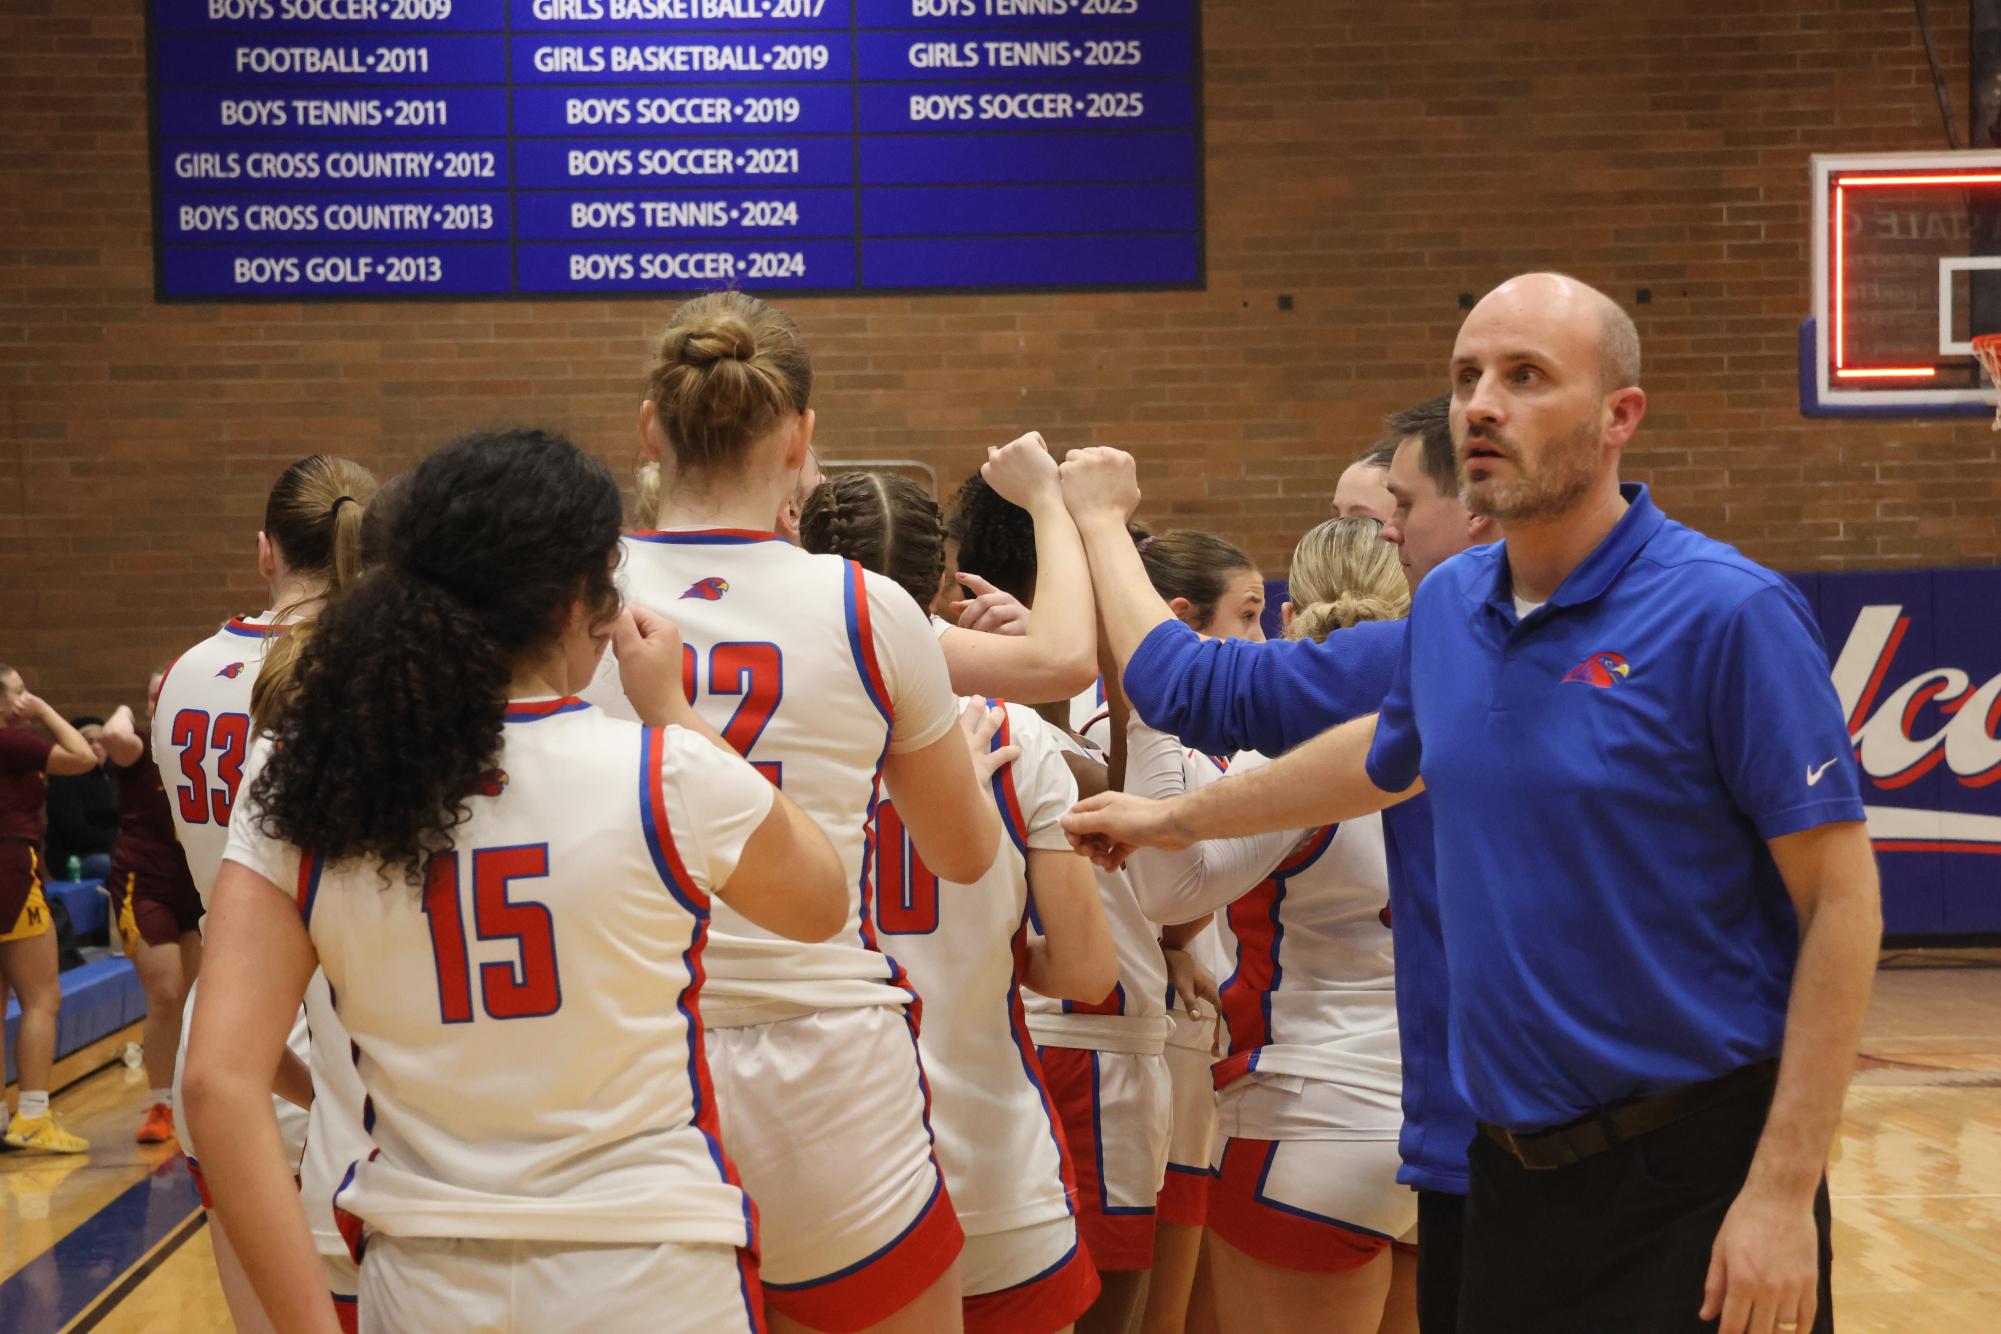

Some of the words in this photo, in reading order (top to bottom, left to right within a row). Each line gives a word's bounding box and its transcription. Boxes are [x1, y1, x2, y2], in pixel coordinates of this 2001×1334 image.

[208, 0, 275, 20] BOYS
[532, 0, 605, 21] GIRLS
[911, 0, 976, 18] BOYS
[533, 46, 606, 73] GIRLS
[908, 41, 980, 68] GIRLS
[221, 100, 287, 126] BOYS
[566, 98, 632, 125] BOYS
[909, 94, 974, 121] BOYS
[175, 153, 241, 178] GIRLS
[246, 152, 321, 179] CROSS
[568, 149, 634, 176] BOYS
[179, 205, 240, 231] BOYS
[244, 204, 319, 231] CROSS
[570, 201, 636, 229] BOYS
[234, 257, 301, 284] BOYS
[569, 253, 635, 281] BOYS
[171, 709, 249, 826] 33
[26, 906, 42, 926] M
[422, 842, 562, 1024] 15
